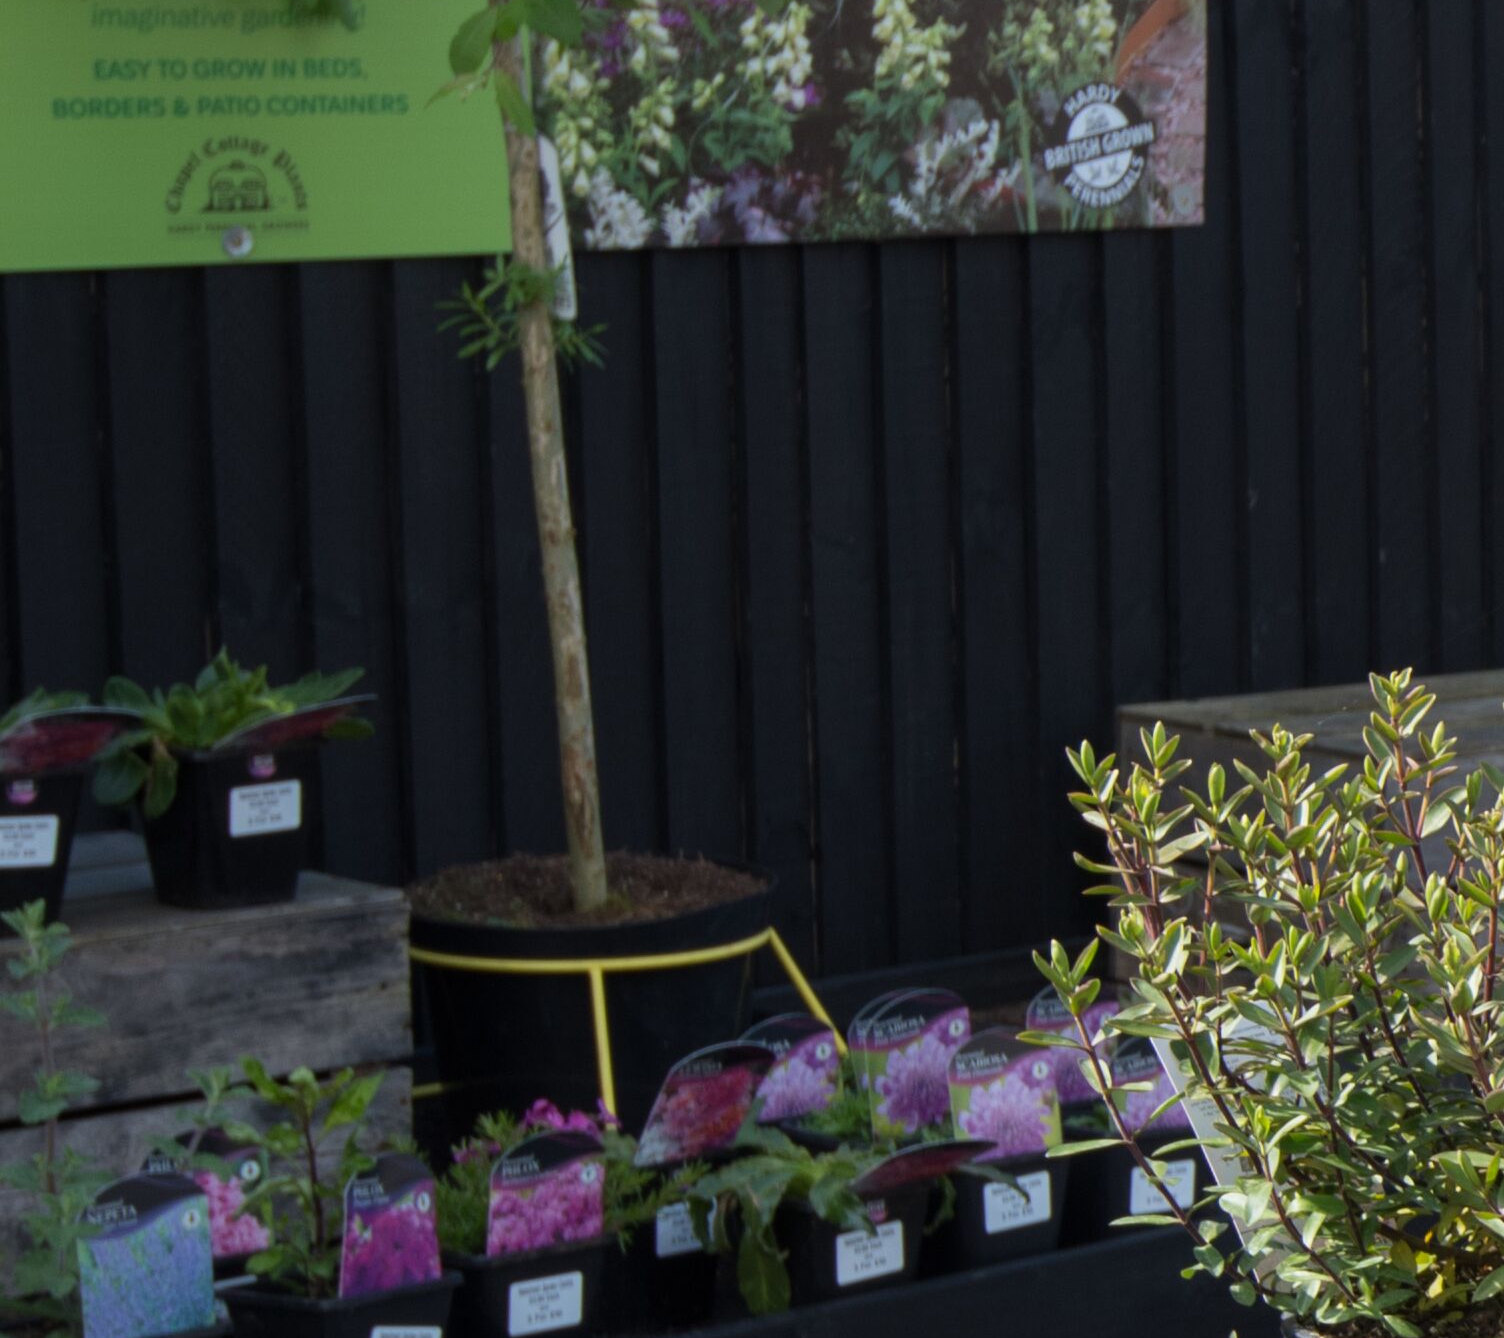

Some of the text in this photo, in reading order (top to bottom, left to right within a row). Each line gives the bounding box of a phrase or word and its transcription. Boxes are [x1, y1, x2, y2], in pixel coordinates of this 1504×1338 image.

[91, 4, 236, 34] imaginative
[93, 58, 151, 82] EASY
[159, 59, 187, 81] TO
[192, 58, 264, 80] GROW
[273, 58, 296, 79] IN
[52, 93, 410, 120] BORDERS & PATIO CONTAINERS
[1063, 83, 1121, 118] HARDY
[1043, 121, 1154, 172] BRITISH GROWN
[1063, 156, 1145, 208] PERENNIALS
